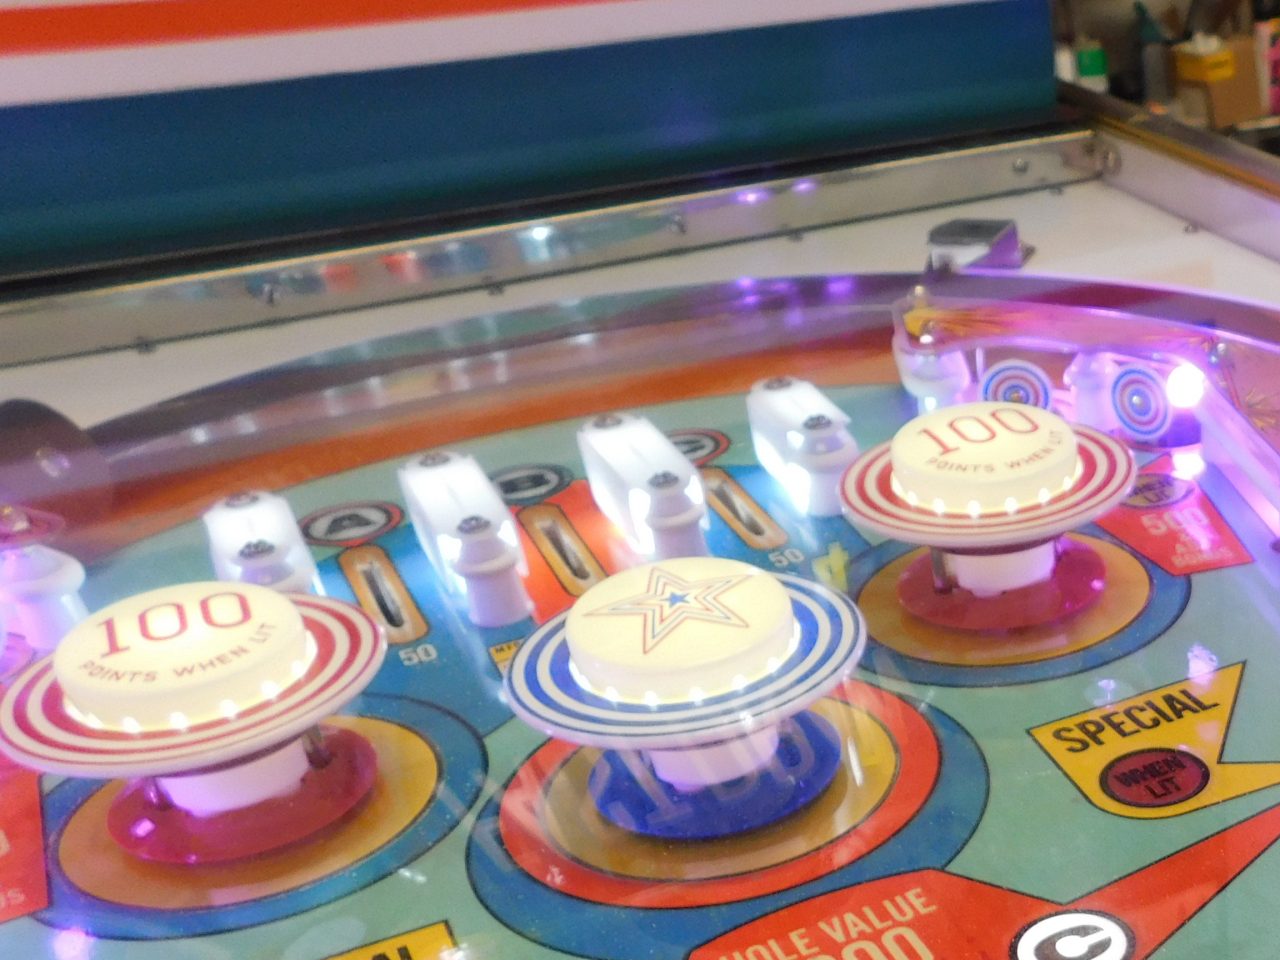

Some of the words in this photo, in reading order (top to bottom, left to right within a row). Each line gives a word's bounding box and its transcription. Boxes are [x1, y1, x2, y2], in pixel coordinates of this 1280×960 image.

[918, 407, 1040, 457] 100
[925, 456, 996, 474] POINTS
[1006, 446, 1055, 470] WHEN
[768, 548, 805, 567] 50
[97, 591, 252, 659] 100
[78, 659, 159, 683] POINTS
[172, 645, 251, 679] WHEN
[249, 621, 277, 645] LIT
[399, 644, 437, 666] 50
[1052, 689, 1220, 753] SPECIAL
[1113, 755, 1187, 788] WHEN
[1144, 776, 1182, 798] LIT
[818, 887, 938, 945] VALUE
